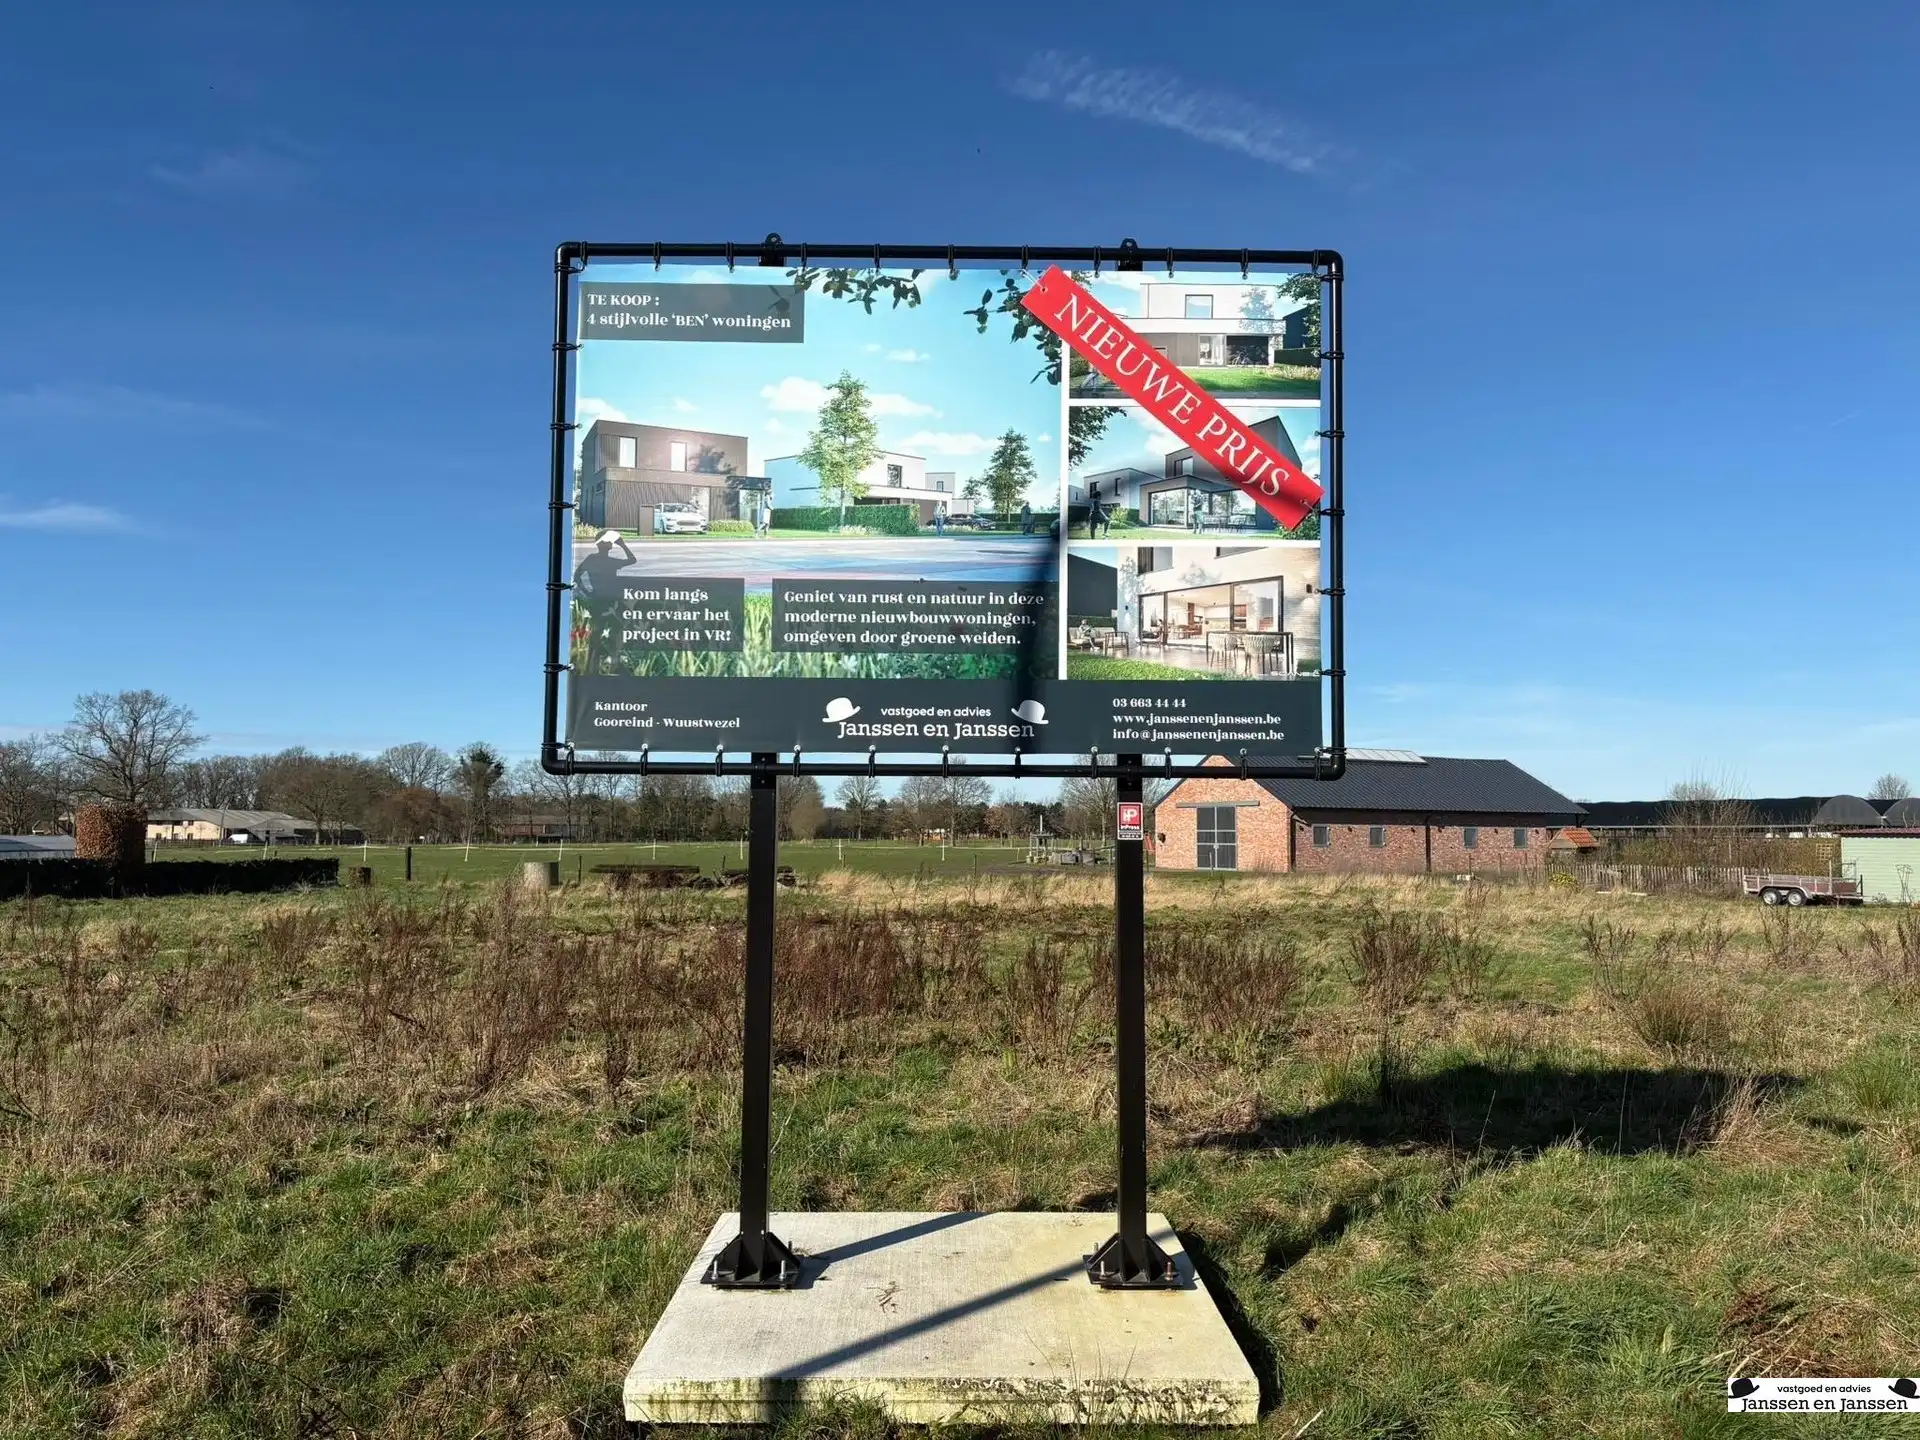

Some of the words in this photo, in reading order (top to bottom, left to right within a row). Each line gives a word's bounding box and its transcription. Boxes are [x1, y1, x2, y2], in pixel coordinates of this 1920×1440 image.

[587, 293, 607, 306] TE
[610, 294, 652, 306] KOOP
[586, 313, 596, 325] 4
[599, 312, 669, 329] stijlvolle
[712, 314, 791, 331] woningen
[1053, 292, 1202, 425] NIEUWE
[1195, 410, 1290, 497] PRIJS
[623, 588, 660, 600] Kom
[664, 587, 709, 604] langs
[783, 590, 835, 603] Geniet
[838, 593, 867, 603] van
[871, 592, 904, 604] rust
[907, 593, 926, 604] en
[930, 593, 986, 605] natuur
[989, 592, 1005, 605] in
[1008, 592, 1045, 605] deze
[622, 609, 643, 620] en
[646, 609, 701, 621] ervaar
[703, 607, 731, 621] het
[784, 610, 857, 623] moderne
[860, 610, 1036, 628] nieuwbouwwoningen,
[622, 627, 681, 644] project
[684, 627, 700, 641] in
[703, 629, 732, 641] VR!
[783, 630, 857, 646] omgeven
[860, 630, 898, 643] door
[900, 631, 956, 647] groene
[959, 631, 1021, 644] weiden.
[594, 701, 648, 712] Kantoor
[1112, 698, 1128, 708] 03
[1130, 698, 1152, 708] 663
[1154, 698, 1169, 708] 44
[1172, 698, 1187, 708] 44
[880, 706, 935, 718] vastgoed
[936, 709, 951, 717] en
[953, 706, 992, 717] advies
[1112, 712, 1282, 727] www.janssenenjanssen.be
[593, 716, 654, 728] Gooreind
[663, 717, 741, 728] Wuustwezel
[837, 721, 919, 739] Janssen
[923, 724, 950, 738] en
[953, 722, 1035, 740] Janssen
[1112, 728, 1285, 742] info@janssenenjanssen.be
